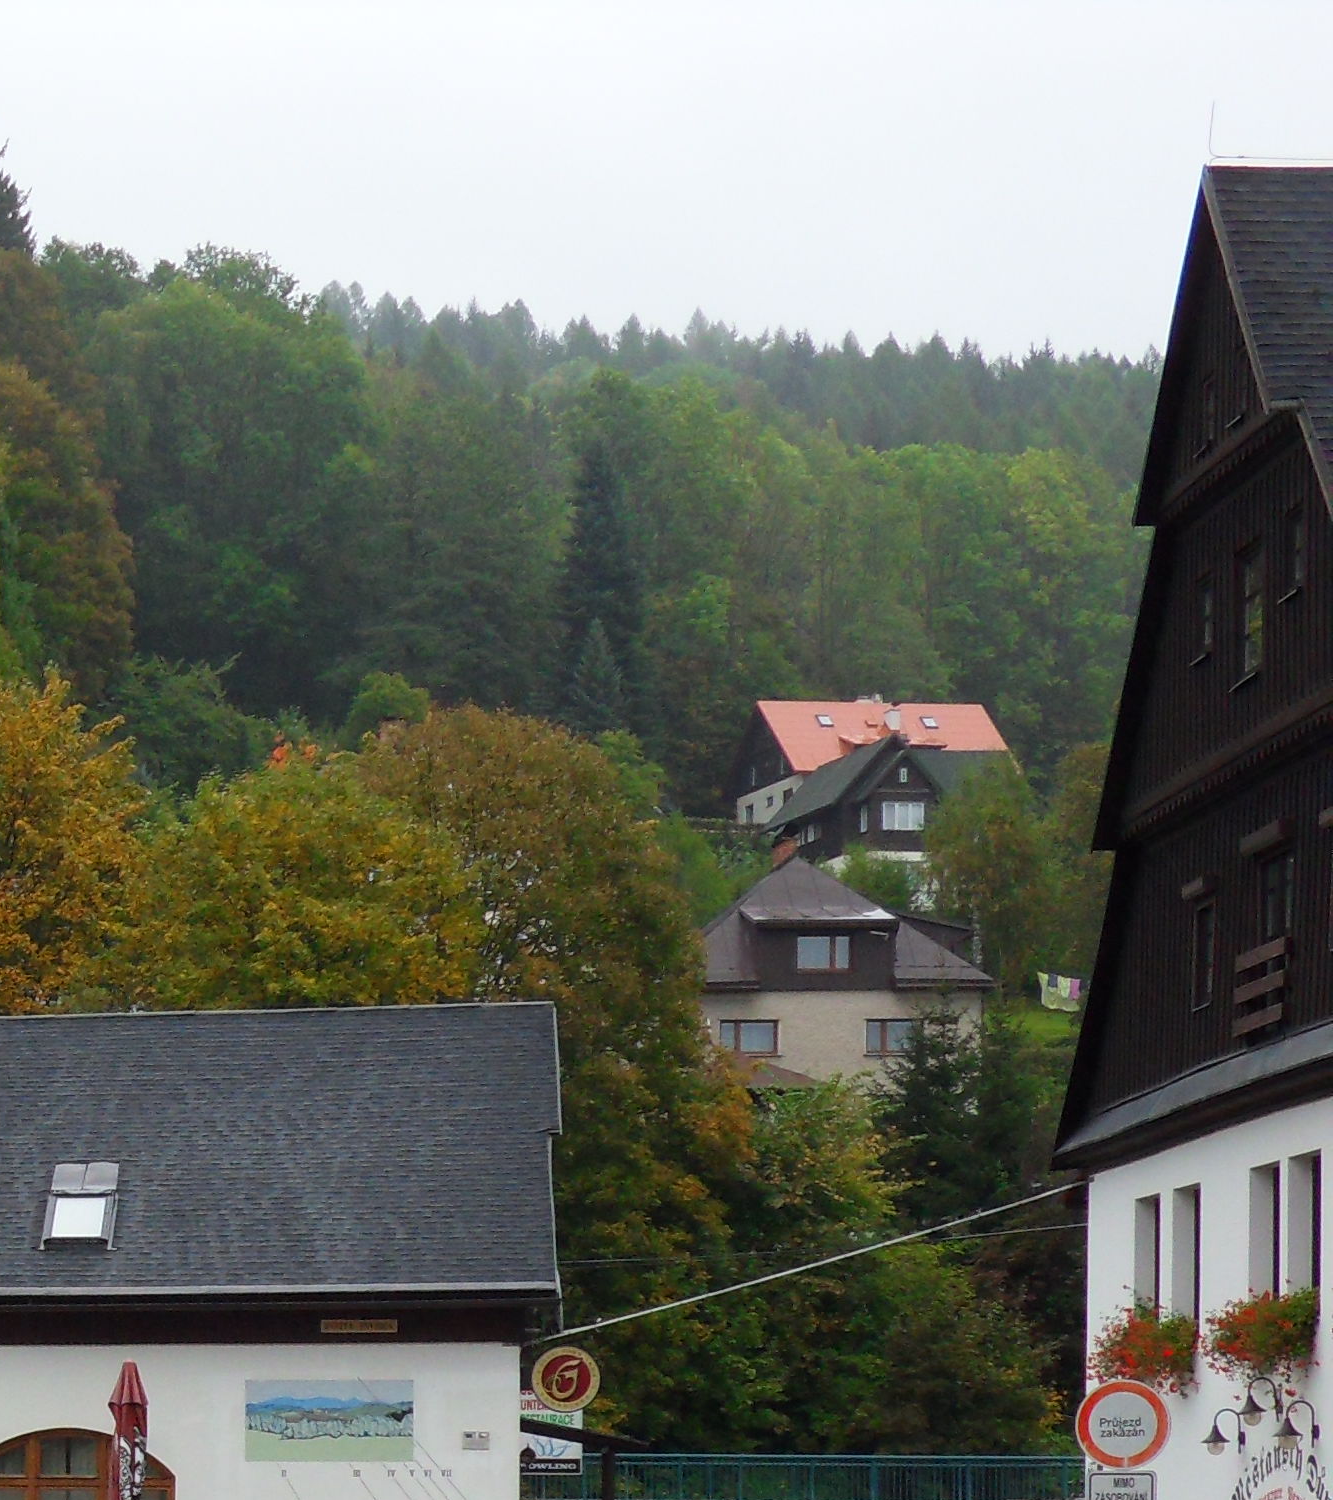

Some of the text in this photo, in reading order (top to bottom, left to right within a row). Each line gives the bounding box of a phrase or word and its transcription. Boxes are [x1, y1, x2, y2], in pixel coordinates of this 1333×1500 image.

[1099, 1416, 1142, 1429] Průjezd
[1100, 1426, 1145, 1438] zakázán
[1113, 1477, 1135, 1488] MIMO
